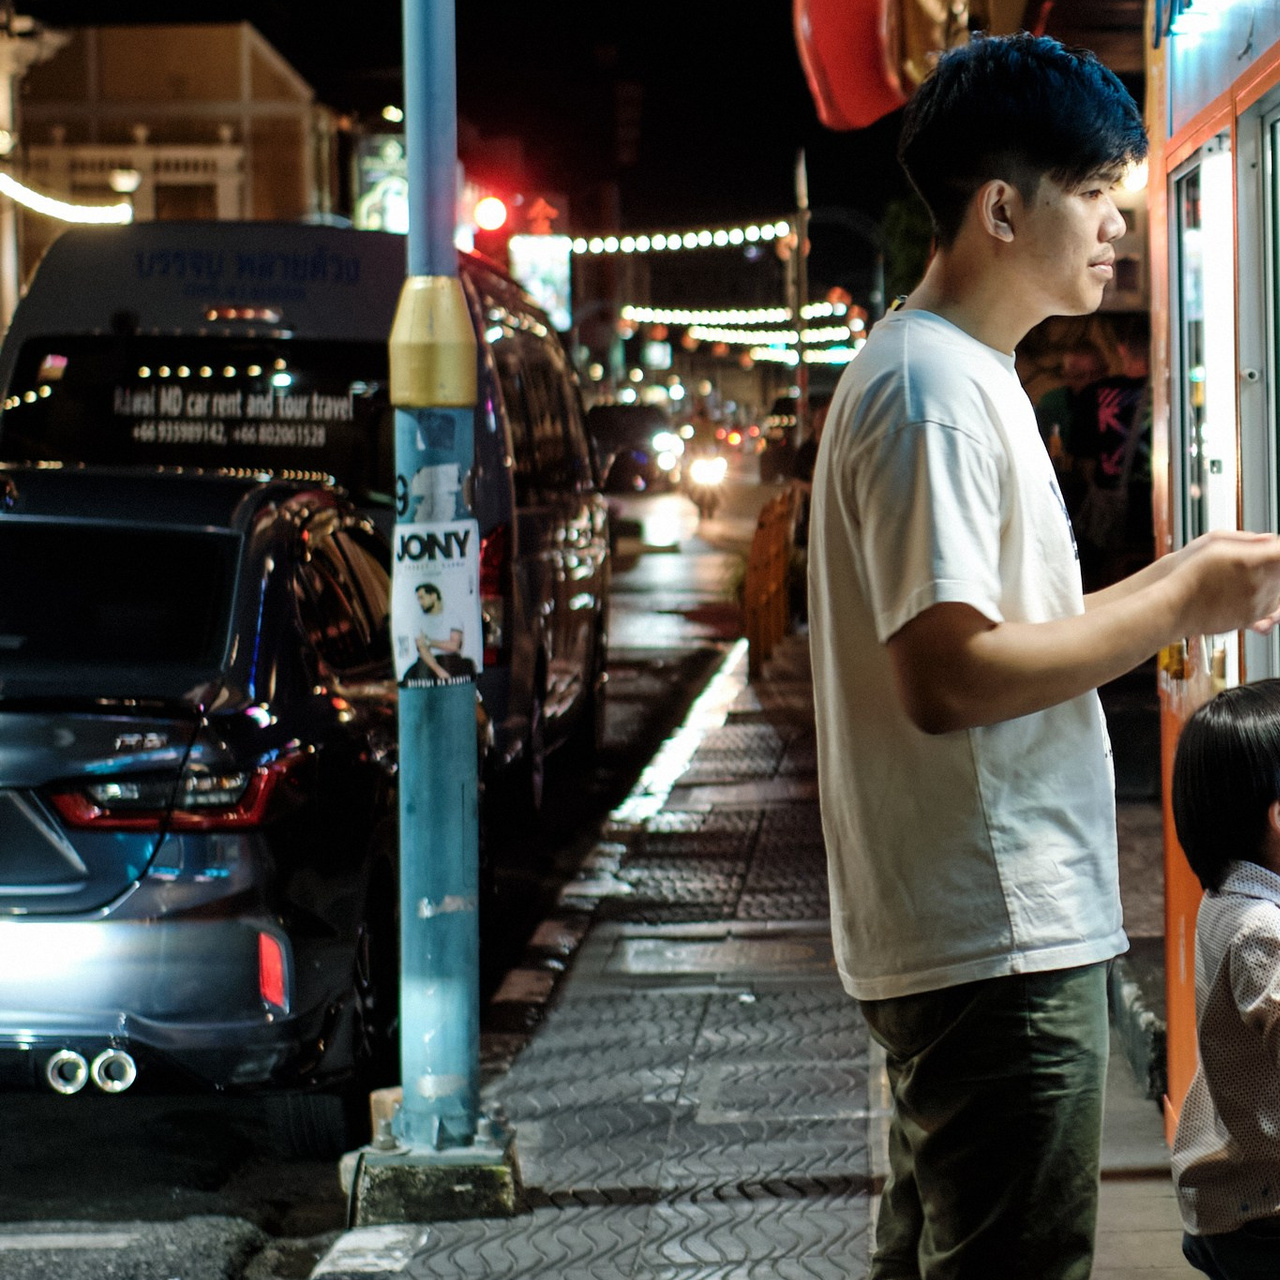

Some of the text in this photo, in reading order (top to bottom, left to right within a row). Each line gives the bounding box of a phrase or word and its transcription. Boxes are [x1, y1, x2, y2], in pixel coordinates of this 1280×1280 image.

[186, 392, 209, 417] car
[212, 389, 243, 418] rent
[246, 385, 275, 418] and
[396, 528, 471, 562] JONY
